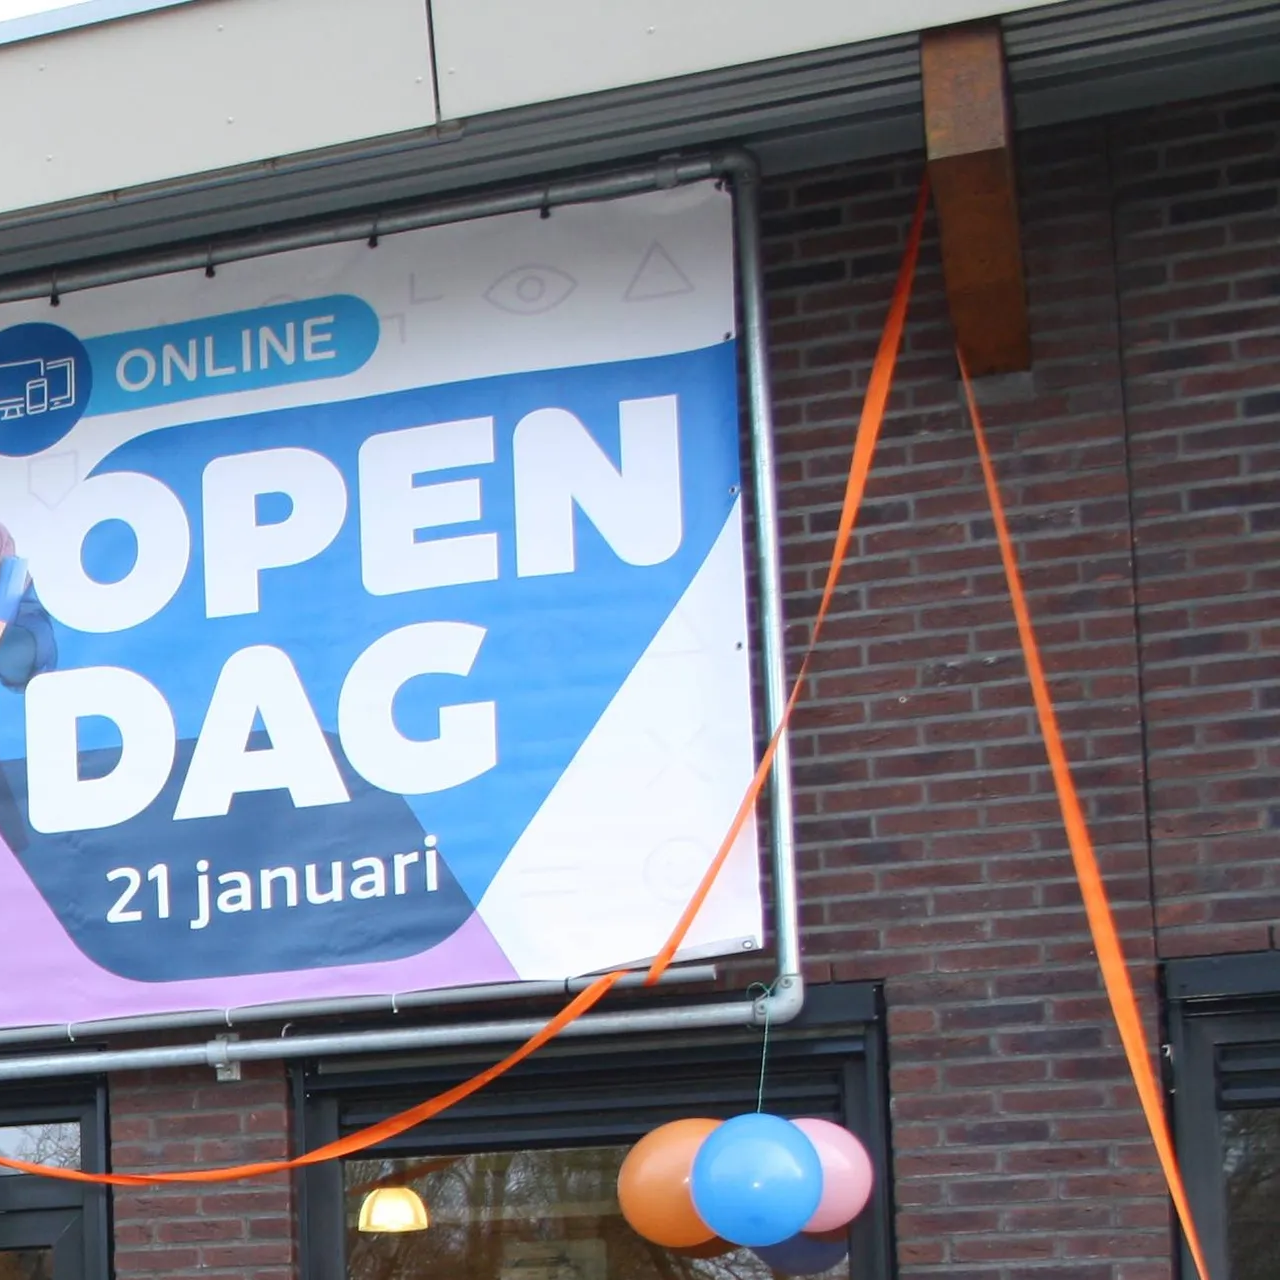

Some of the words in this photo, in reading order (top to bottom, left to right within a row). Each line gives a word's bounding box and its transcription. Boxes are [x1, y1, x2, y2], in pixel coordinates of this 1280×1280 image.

[115, 315, 337, 392] ONLINE
[29, 394, 683, 634] OPEN
[25, 621, 498, 834] DAG
[105, 863, 170, 924] 21
[189, 834, 438, 930] januari
